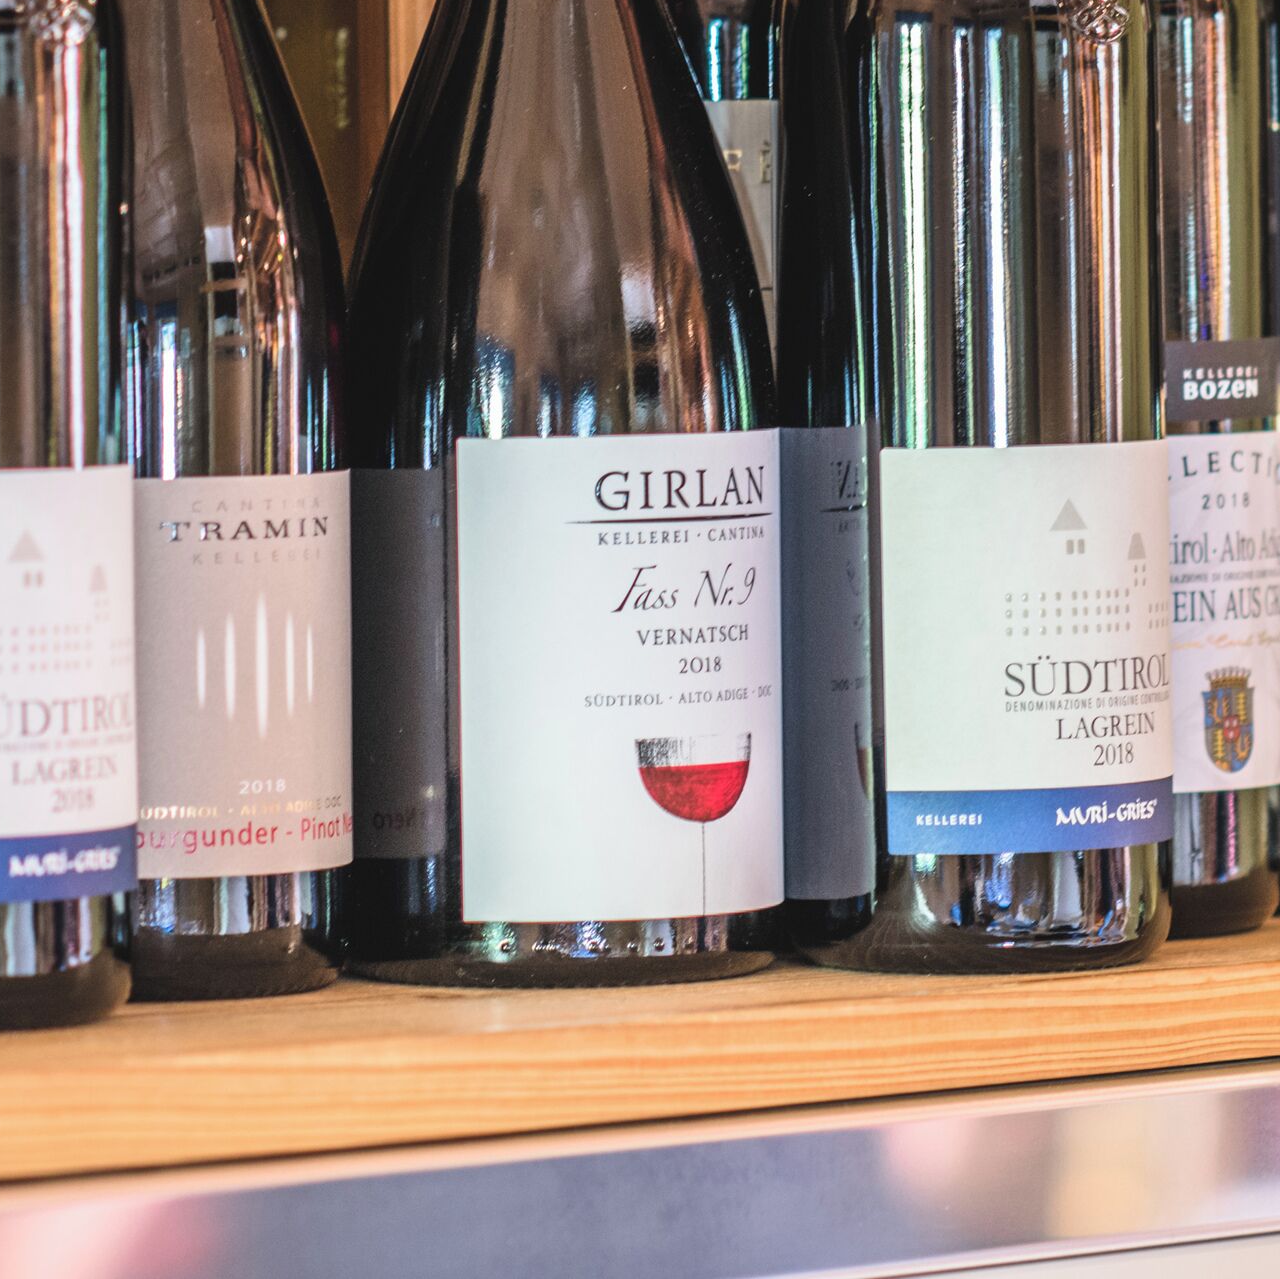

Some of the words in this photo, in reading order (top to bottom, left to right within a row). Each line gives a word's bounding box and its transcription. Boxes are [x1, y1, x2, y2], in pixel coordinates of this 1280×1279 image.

[1183, 366, 1258, 380] KELLEREI
[594, 465, 765, 511] GIRLAN
[1201, 492, 1251, 510] 2018
[158, 516, 329, 543] TRAMIN
[597, 529, 690, 546] KELLEREI
[707, 526, 765, 542] CANTINA
[1220, 530, 1256, 563] Alto
[610, 564, 680, 613] Fass
[1224, 586, 1262, 621] AUS
[636, 624, 750, 647] VERNATSCH
[678, 656, 723, 675] 2018
[1004, 652, 1170, 698] SÜDTIROL
[584, 692, 664, 709] SÜDTIROL
[678, 690, 713, 705] ALTO
[716, 687, 749, 702] ADIGE
[1005, 698, 1093, 713] DENOMINAZIONE
[1096, 697, 1106, 709] DI
[1108, 694, 1139, 708] ORIGINE
[1056, 711, 1156, 741] LAGREIN
[1093, 742, 1135, 767] 2018
[11, 754, 118, 787] LAGREIN
[238, 778, 288, 796] 2018
[300, 813, 341, 842] Pinot
[916, 813, 983, 827] KELLEREI
